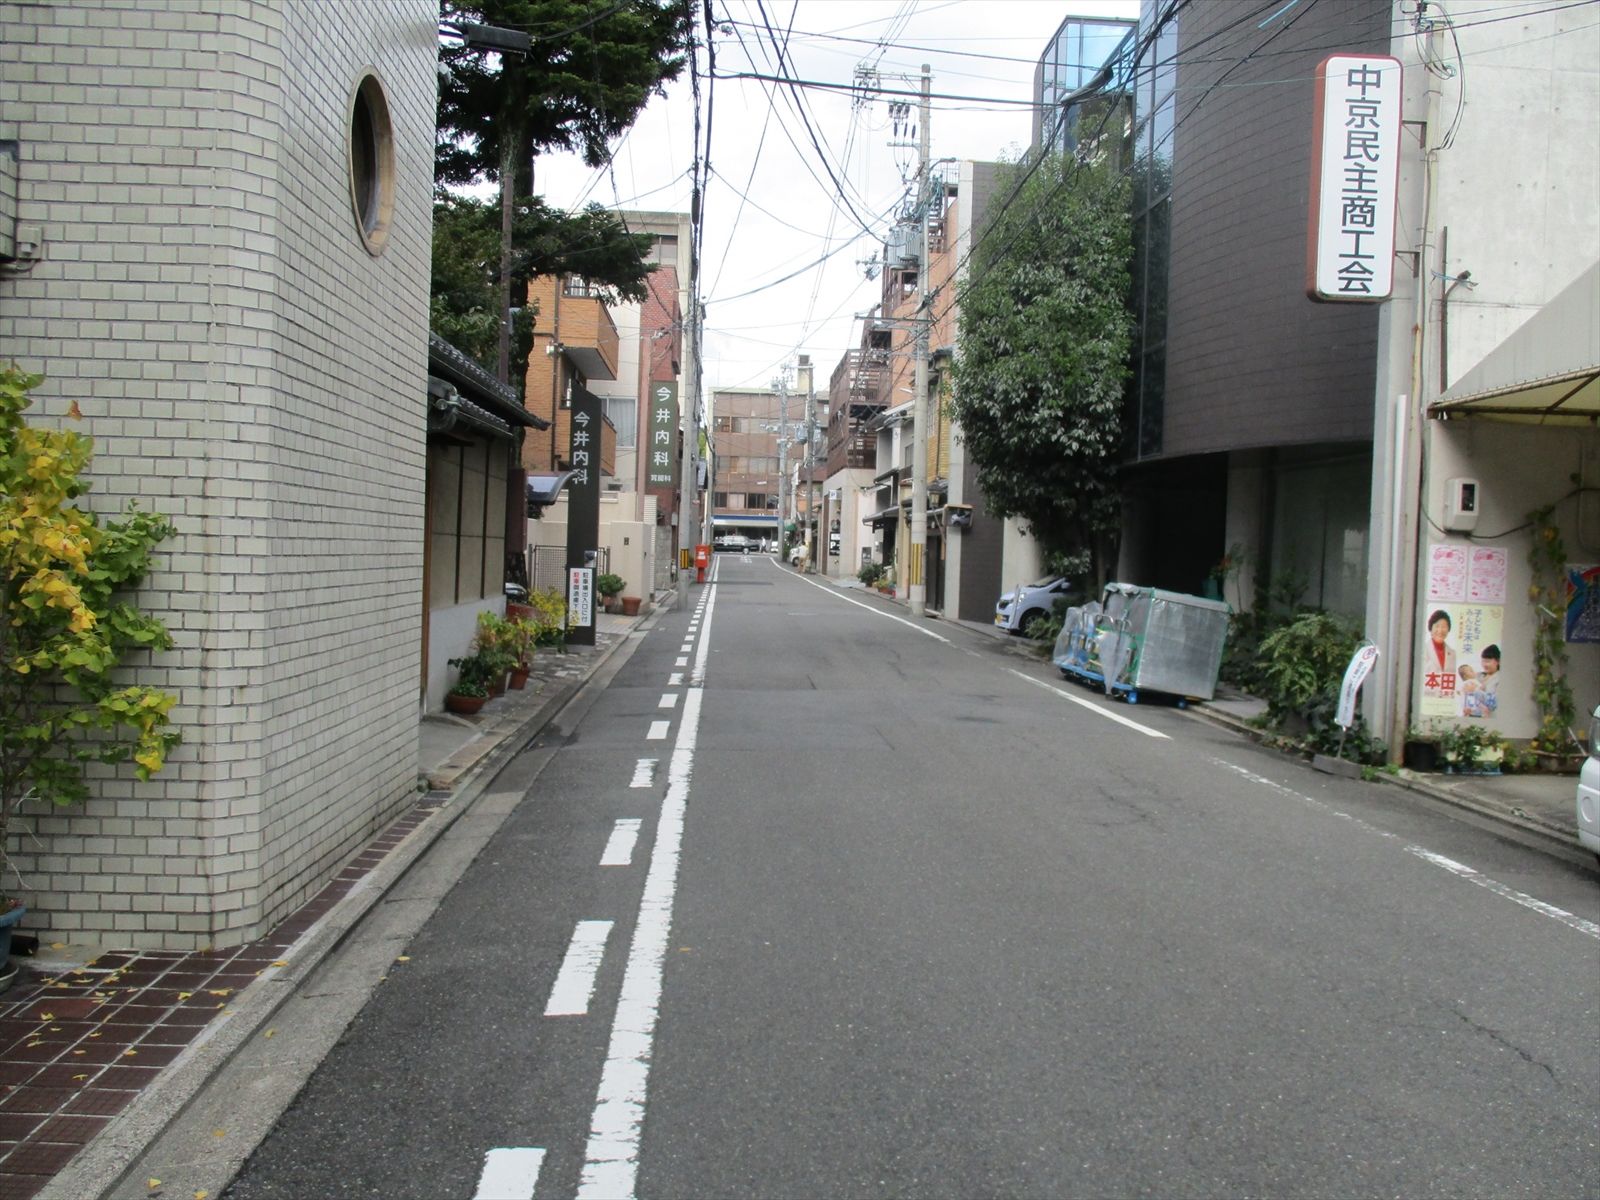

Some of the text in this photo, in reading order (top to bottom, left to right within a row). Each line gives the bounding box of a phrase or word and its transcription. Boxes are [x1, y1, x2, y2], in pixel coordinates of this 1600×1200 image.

[1337, 63, 1382, 294] 中京民主商工会
[572, 411, 590, 485] 今井内科
[653, 386, 672, 466] 今井内科
[1424, 671, 1456, 691] 本田
